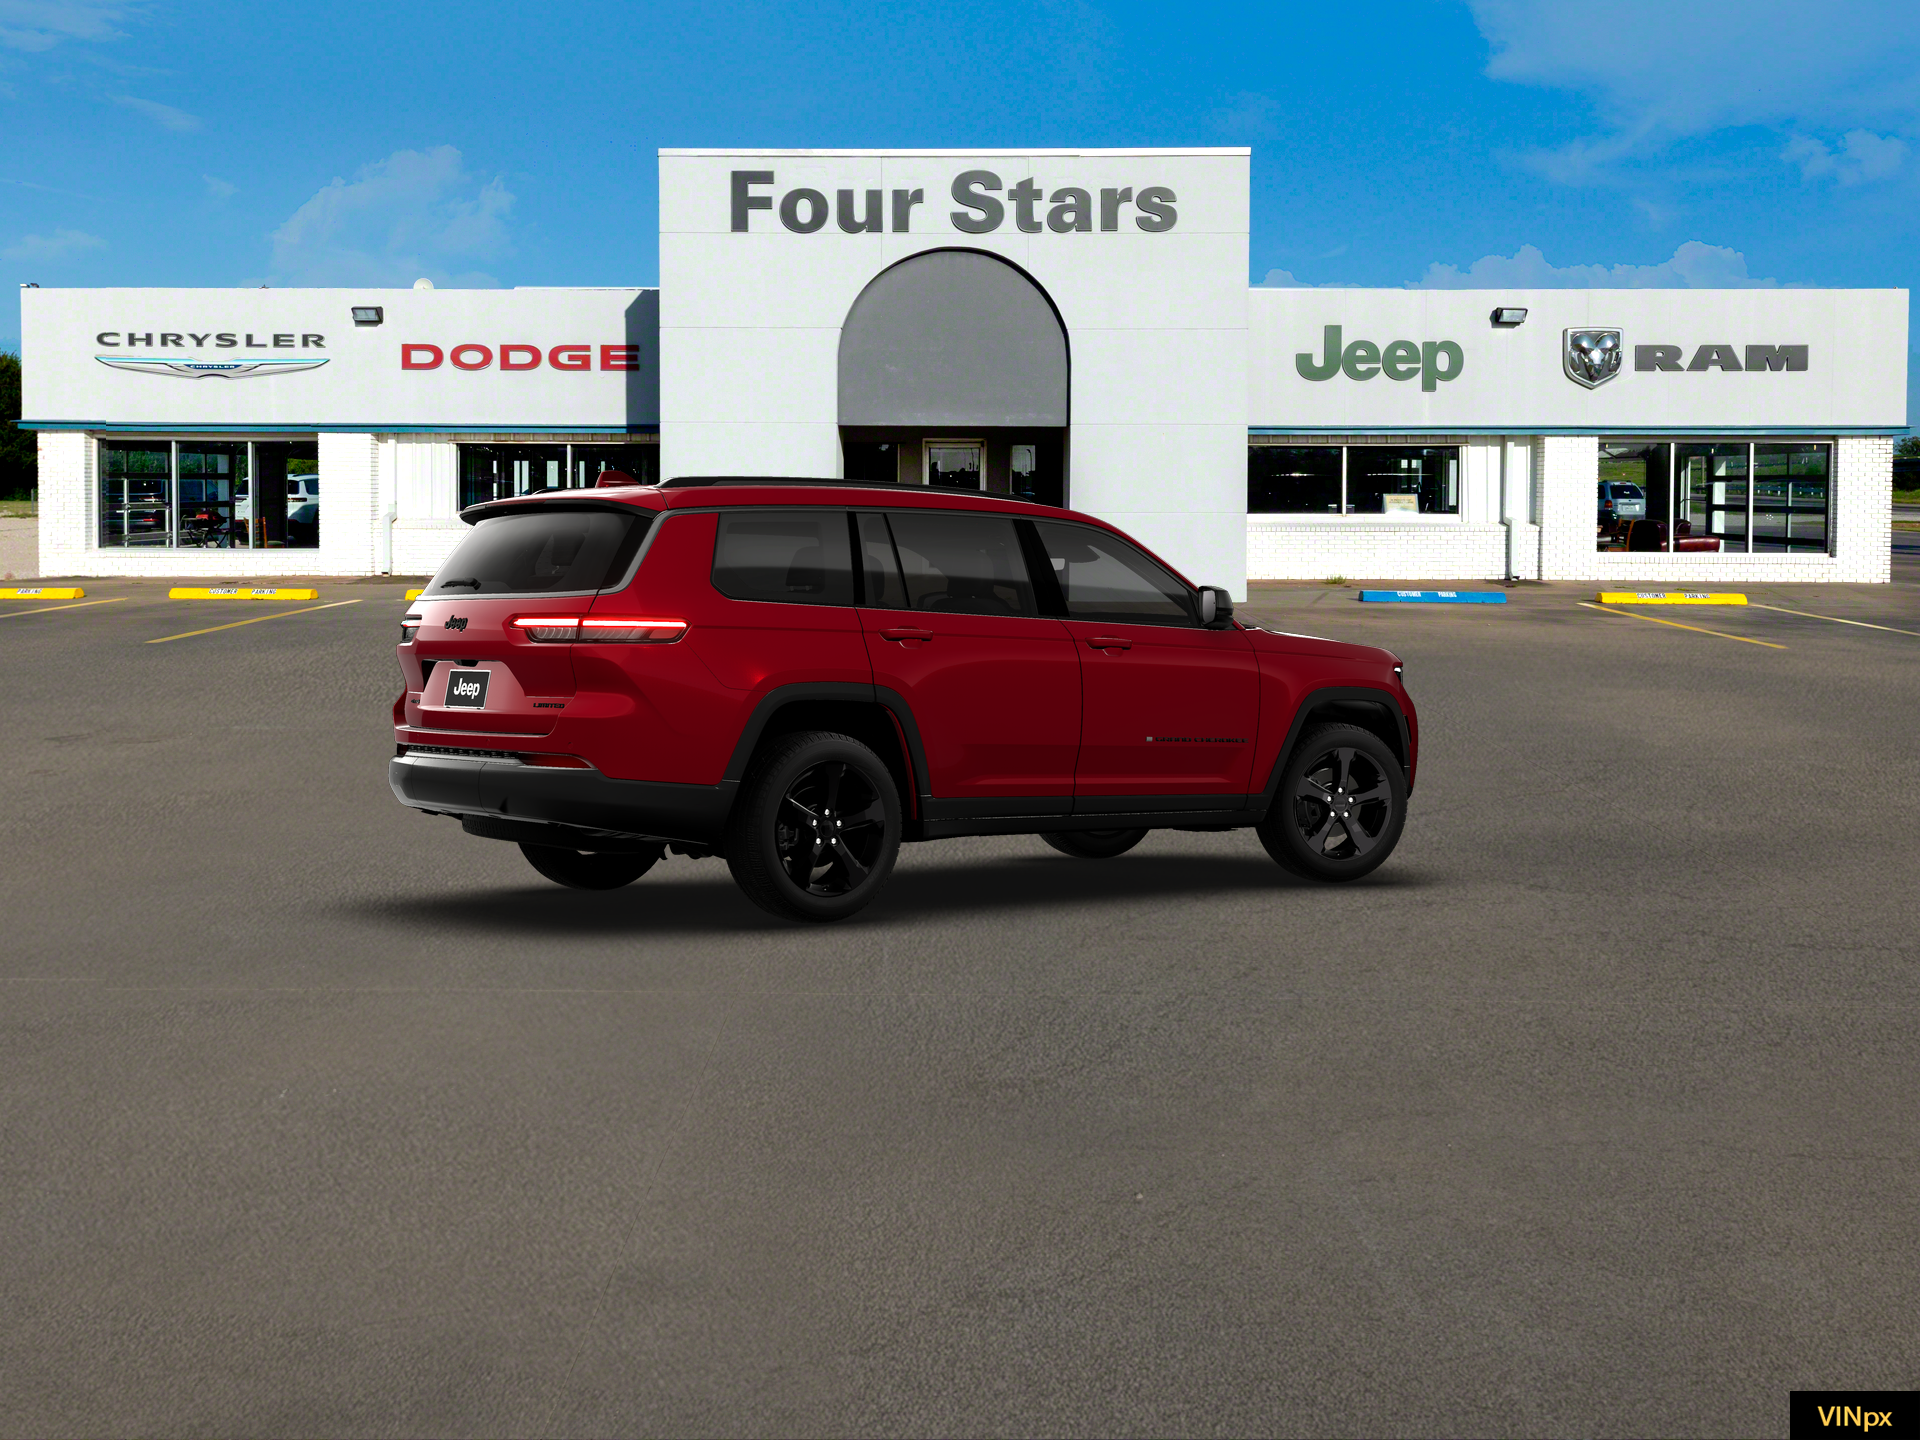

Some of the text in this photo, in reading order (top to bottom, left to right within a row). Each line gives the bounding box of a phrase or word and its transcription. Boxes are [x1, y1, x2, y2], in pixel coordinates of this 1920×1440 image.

[730, 169, 1178, 233] Four Stars
[96, 332, 326, 349] CHRYSLER
[401, 343, 640, 371] DODGE
[1294, 324, 1464, 392] Jeep
[1634, 343, 1809, 373] RAM
[445, 615, 468, 632] Jeep
[454, 678, 480, 699] Jeep
